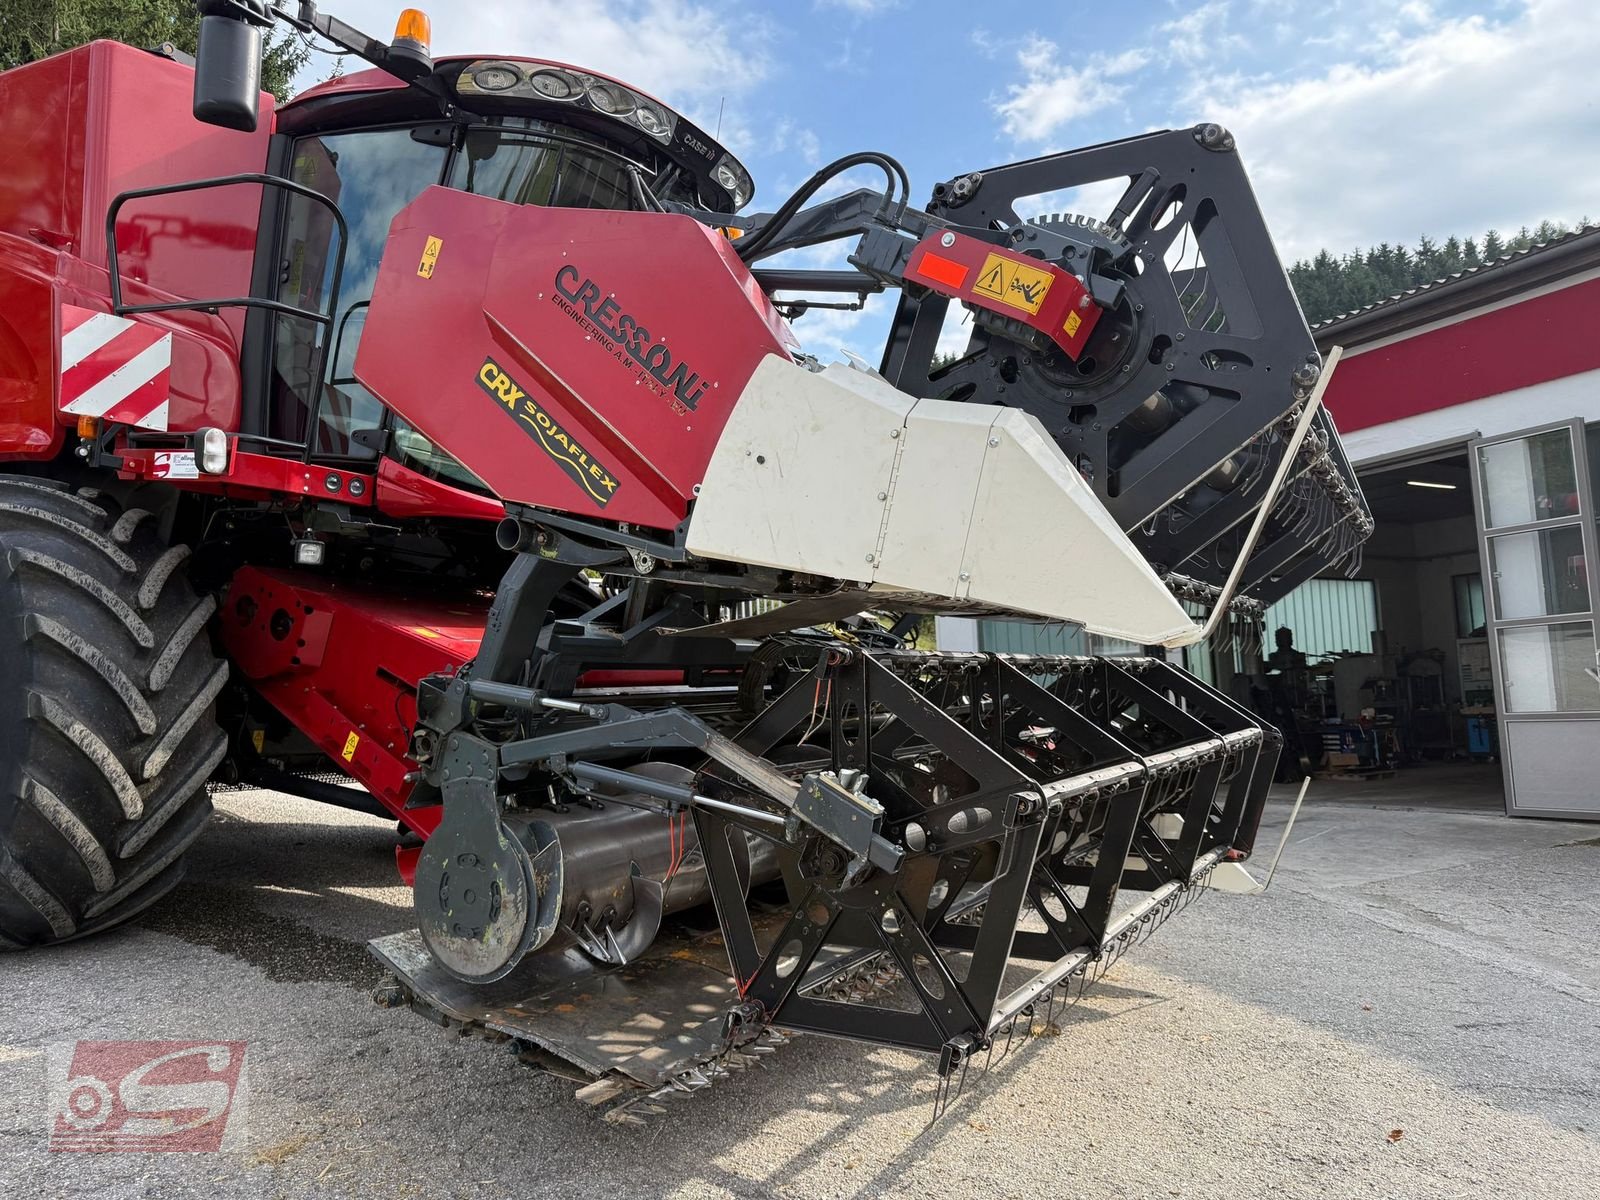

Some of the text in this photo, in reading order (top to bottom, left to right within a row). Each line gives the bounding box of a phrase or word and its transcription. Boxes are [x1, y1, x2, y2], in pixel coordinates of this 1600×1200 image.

[684, 133, 708, 156] CASE
[551, 294, 615, 353] ENGINEERING
[479, 362, 618, 494] CRX SOJAFLEX
